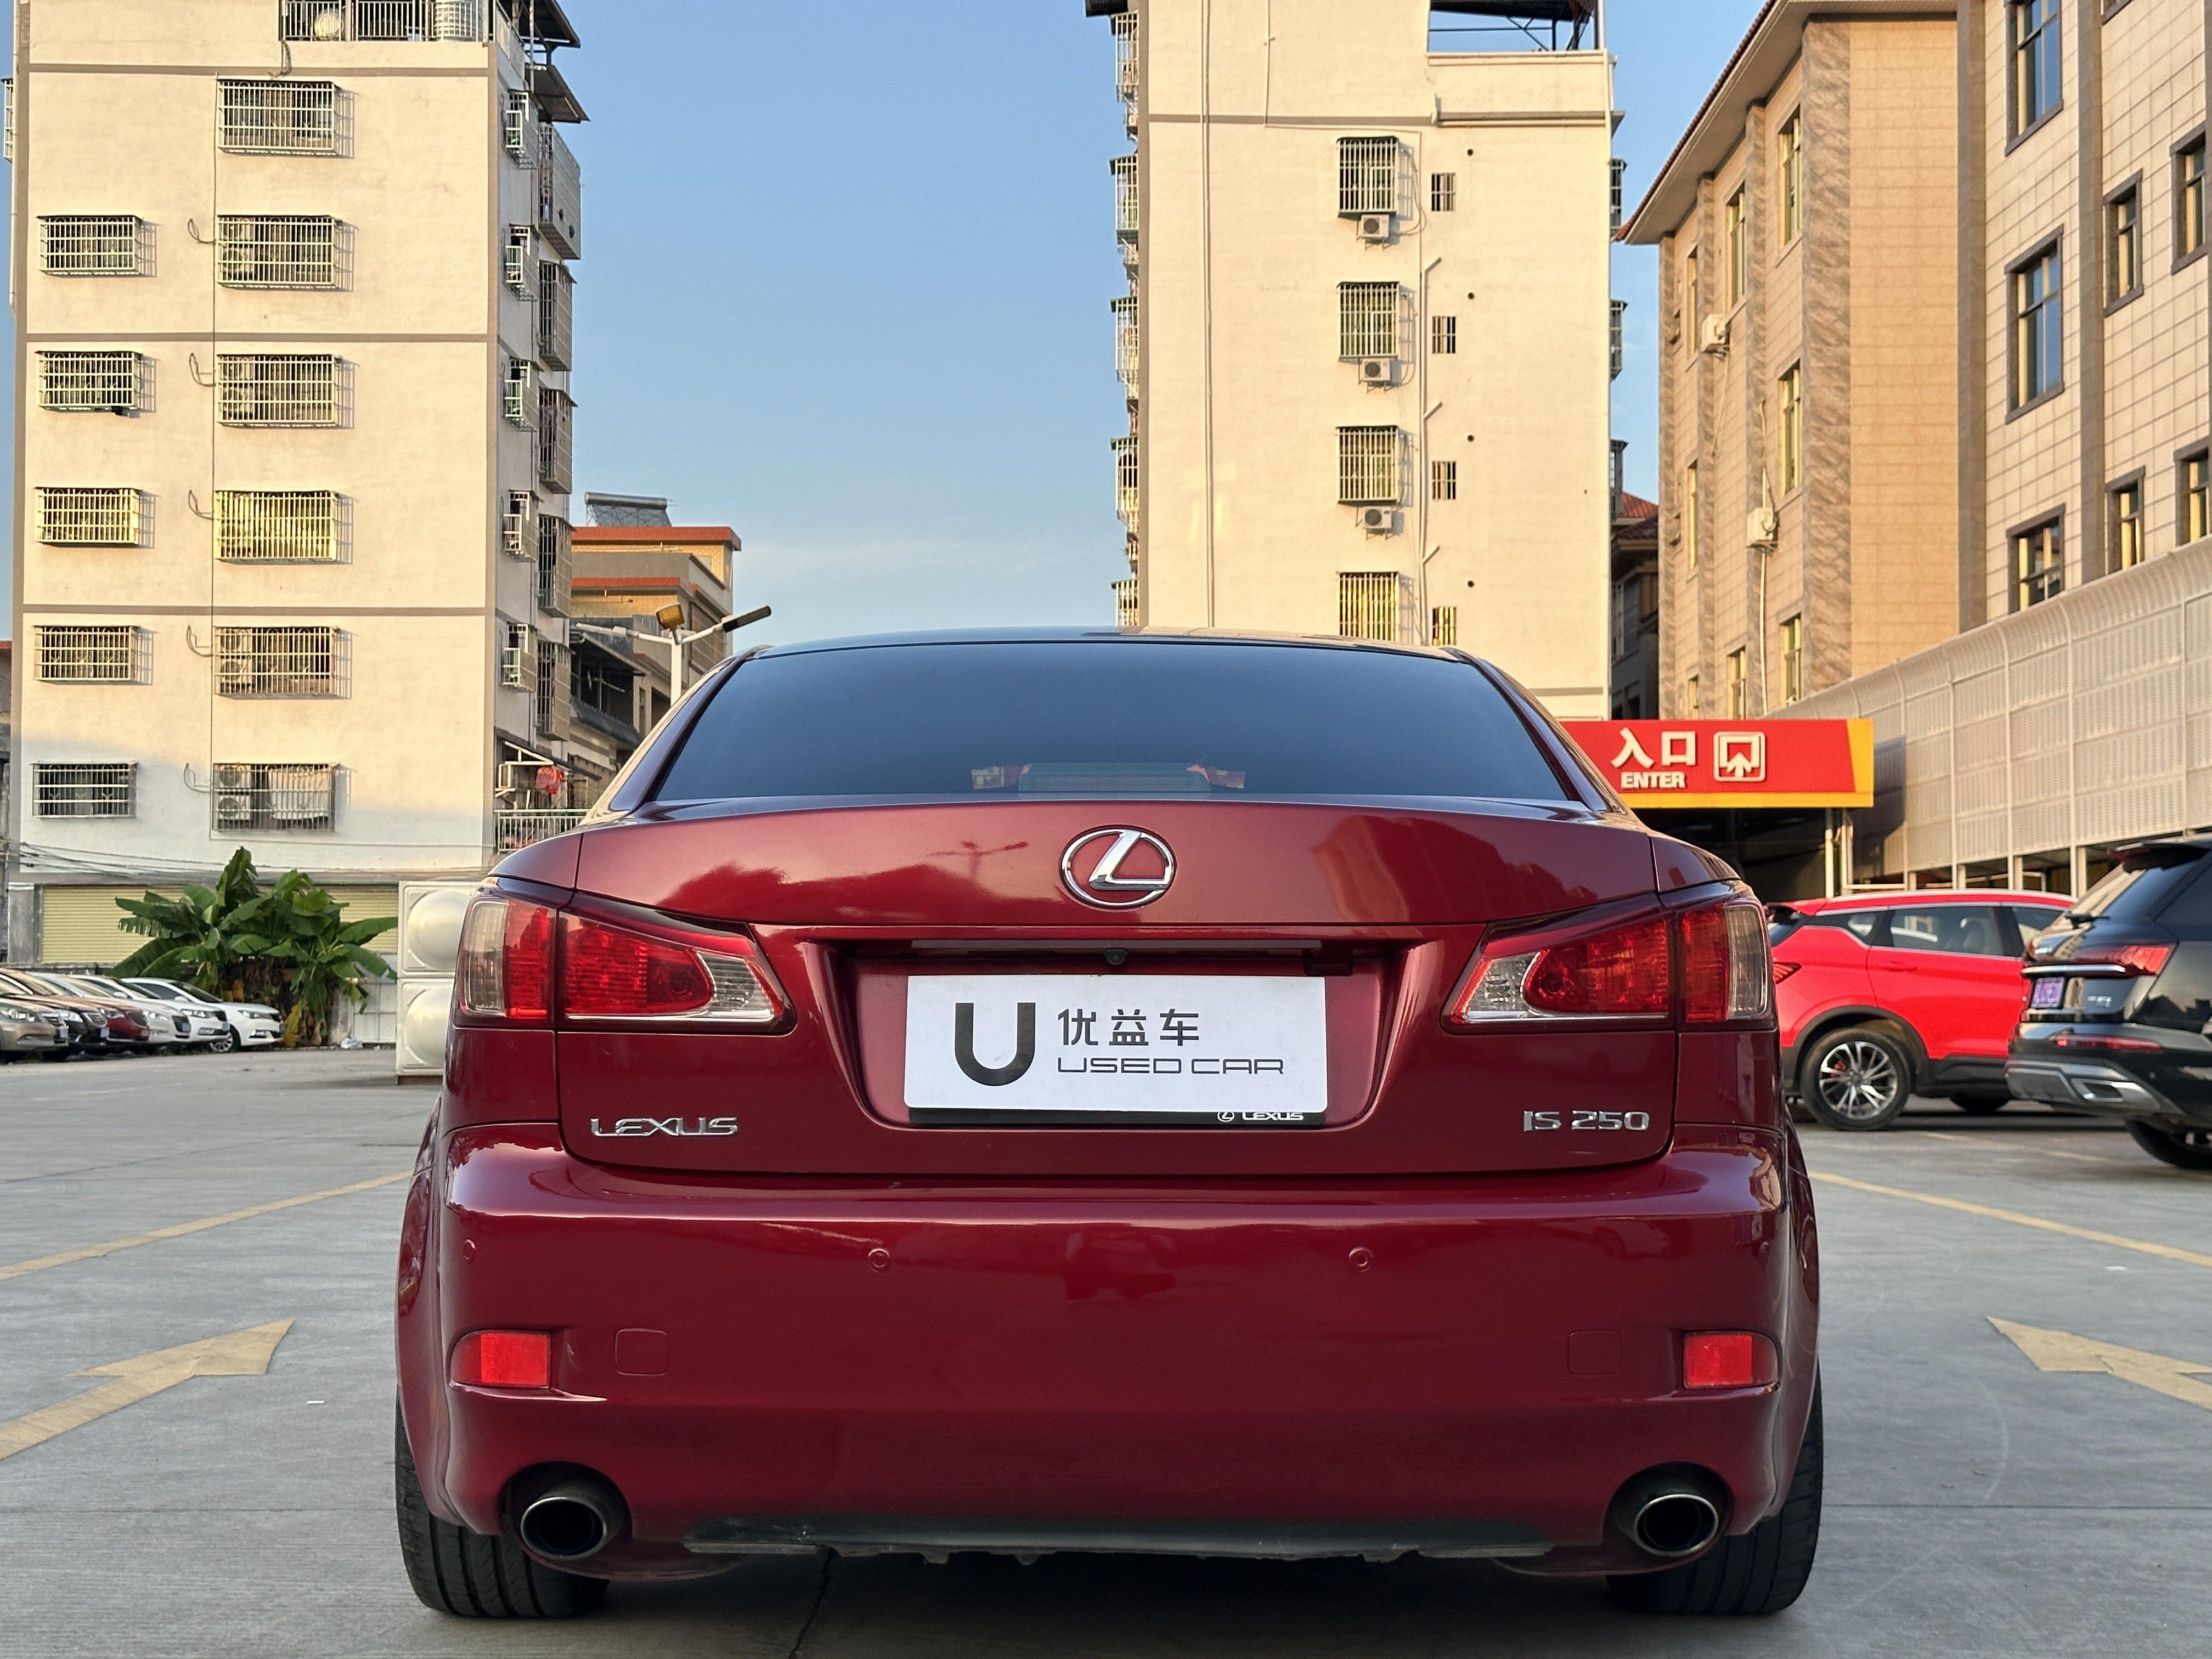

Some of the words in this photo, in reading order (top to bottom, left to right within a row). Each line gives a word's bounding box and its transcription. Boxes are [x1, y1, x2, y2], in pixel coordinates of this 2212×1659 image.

[1610, 726, 1698, 768] 入口
[1621, 771, 1686, 789] ENTER
[1057, 1008, 1200, 1046] 优益车
[955, 1002, 1036, 1087] U
[1057, 1057, 1182, 1075] USED
[1191, 1058, 1284, 1075] CAR
[1242, 1111, 1304, 1120] LEXUS
[1523, 1110, 1562, 1132] IS
[1571, 1110, 1650, 1131] 250
[590, 1117, 738, 1137] LEXUS
